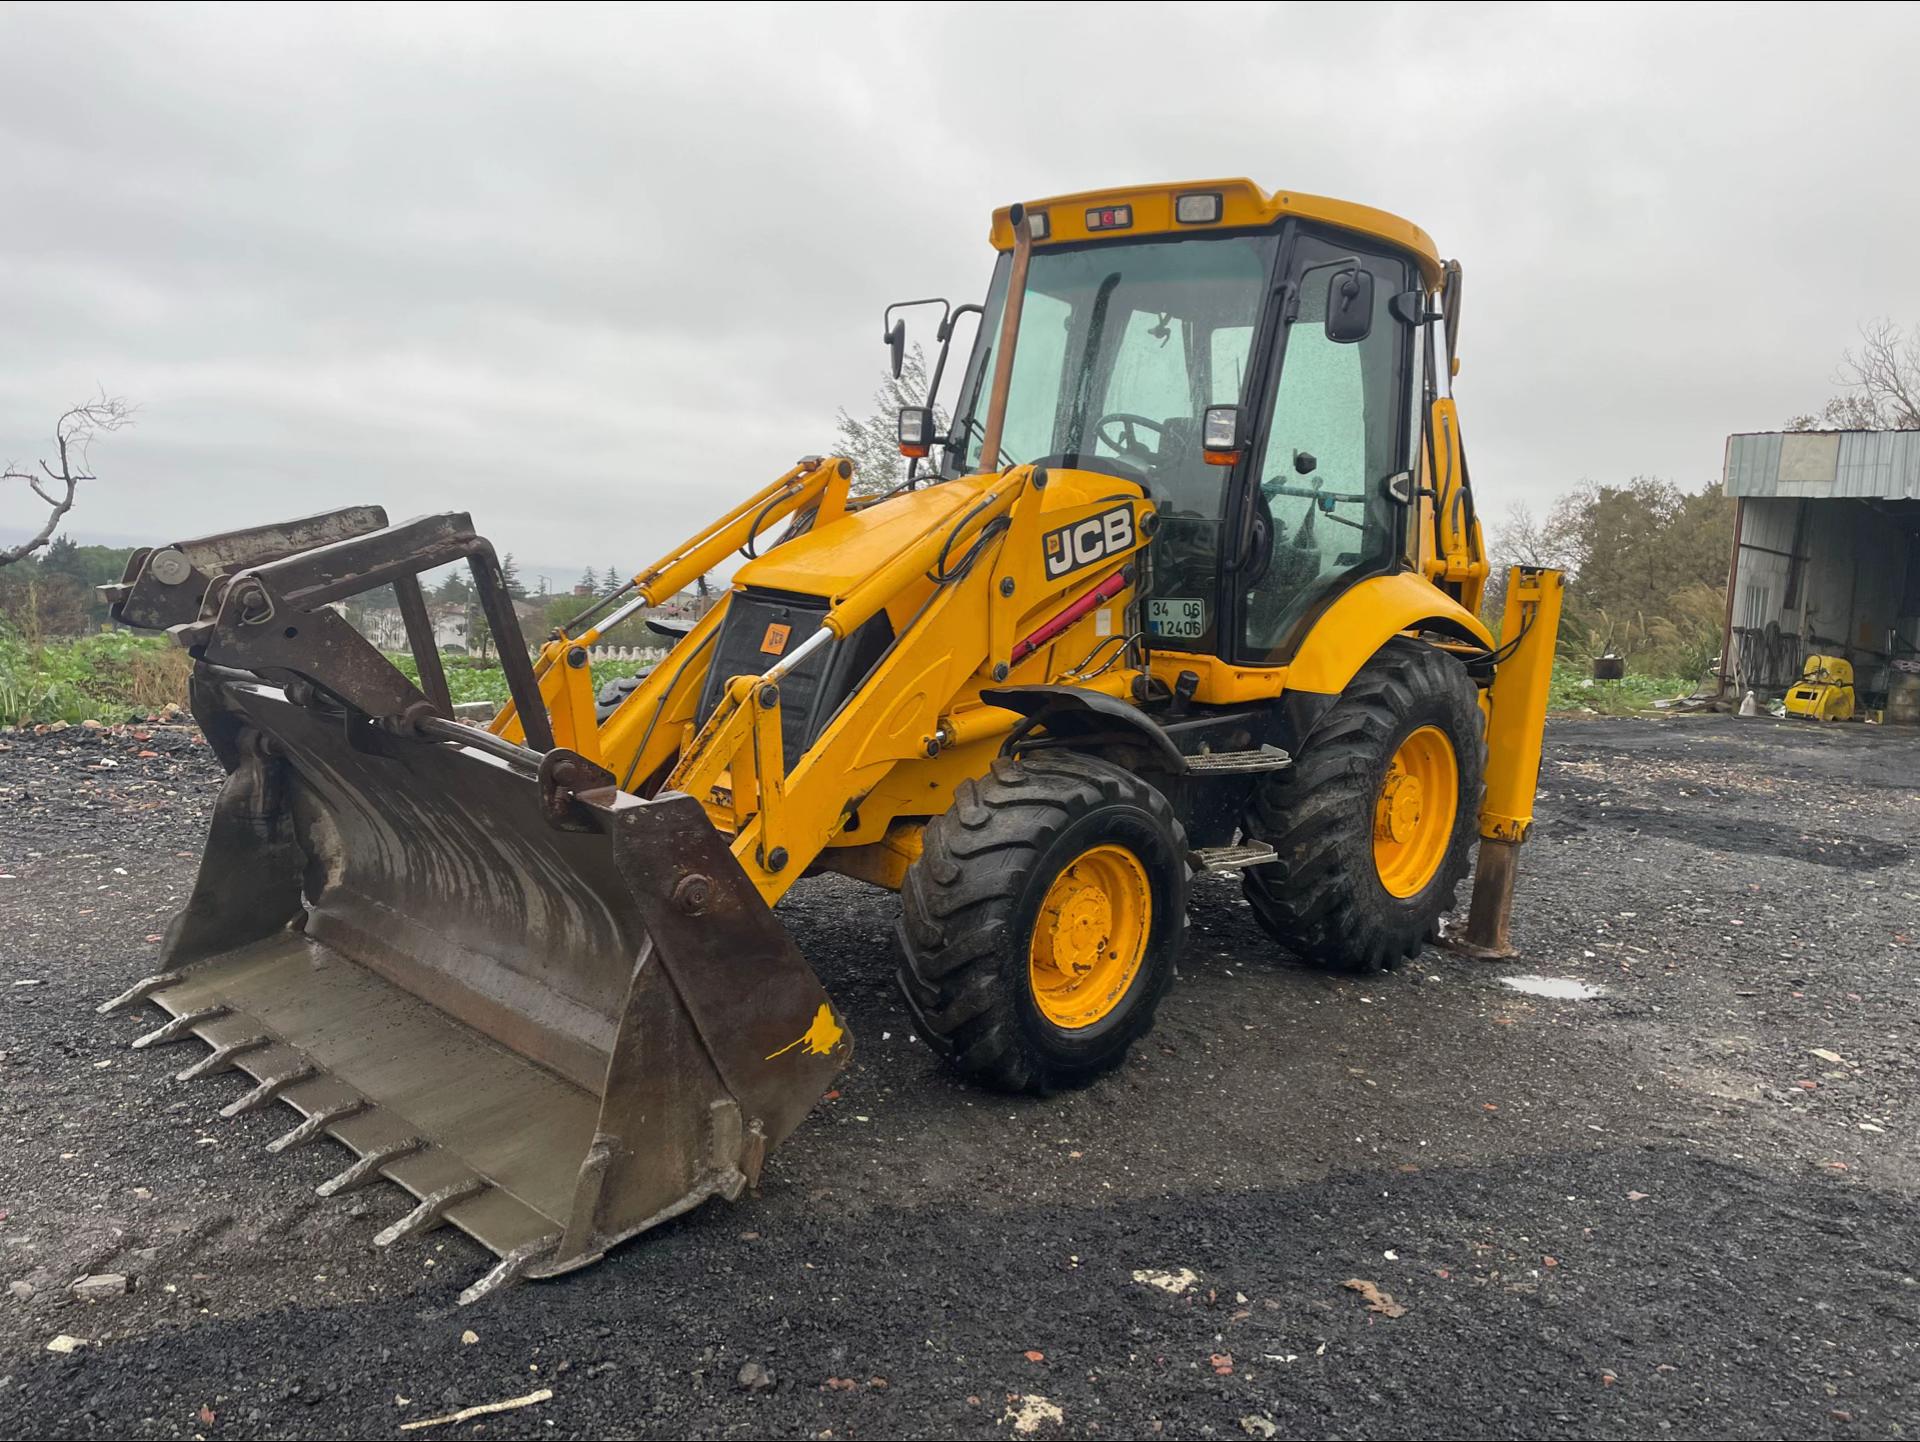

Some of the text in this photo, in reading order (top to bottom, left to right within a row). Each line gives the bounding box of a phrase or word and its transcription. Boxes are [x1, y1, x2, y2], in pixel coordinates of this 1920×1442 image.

[1049, 508, 1133, 575] JCB
[1152, 601, 1201, 618] 34 06
[1159, 620, 1202, 636] 12406
